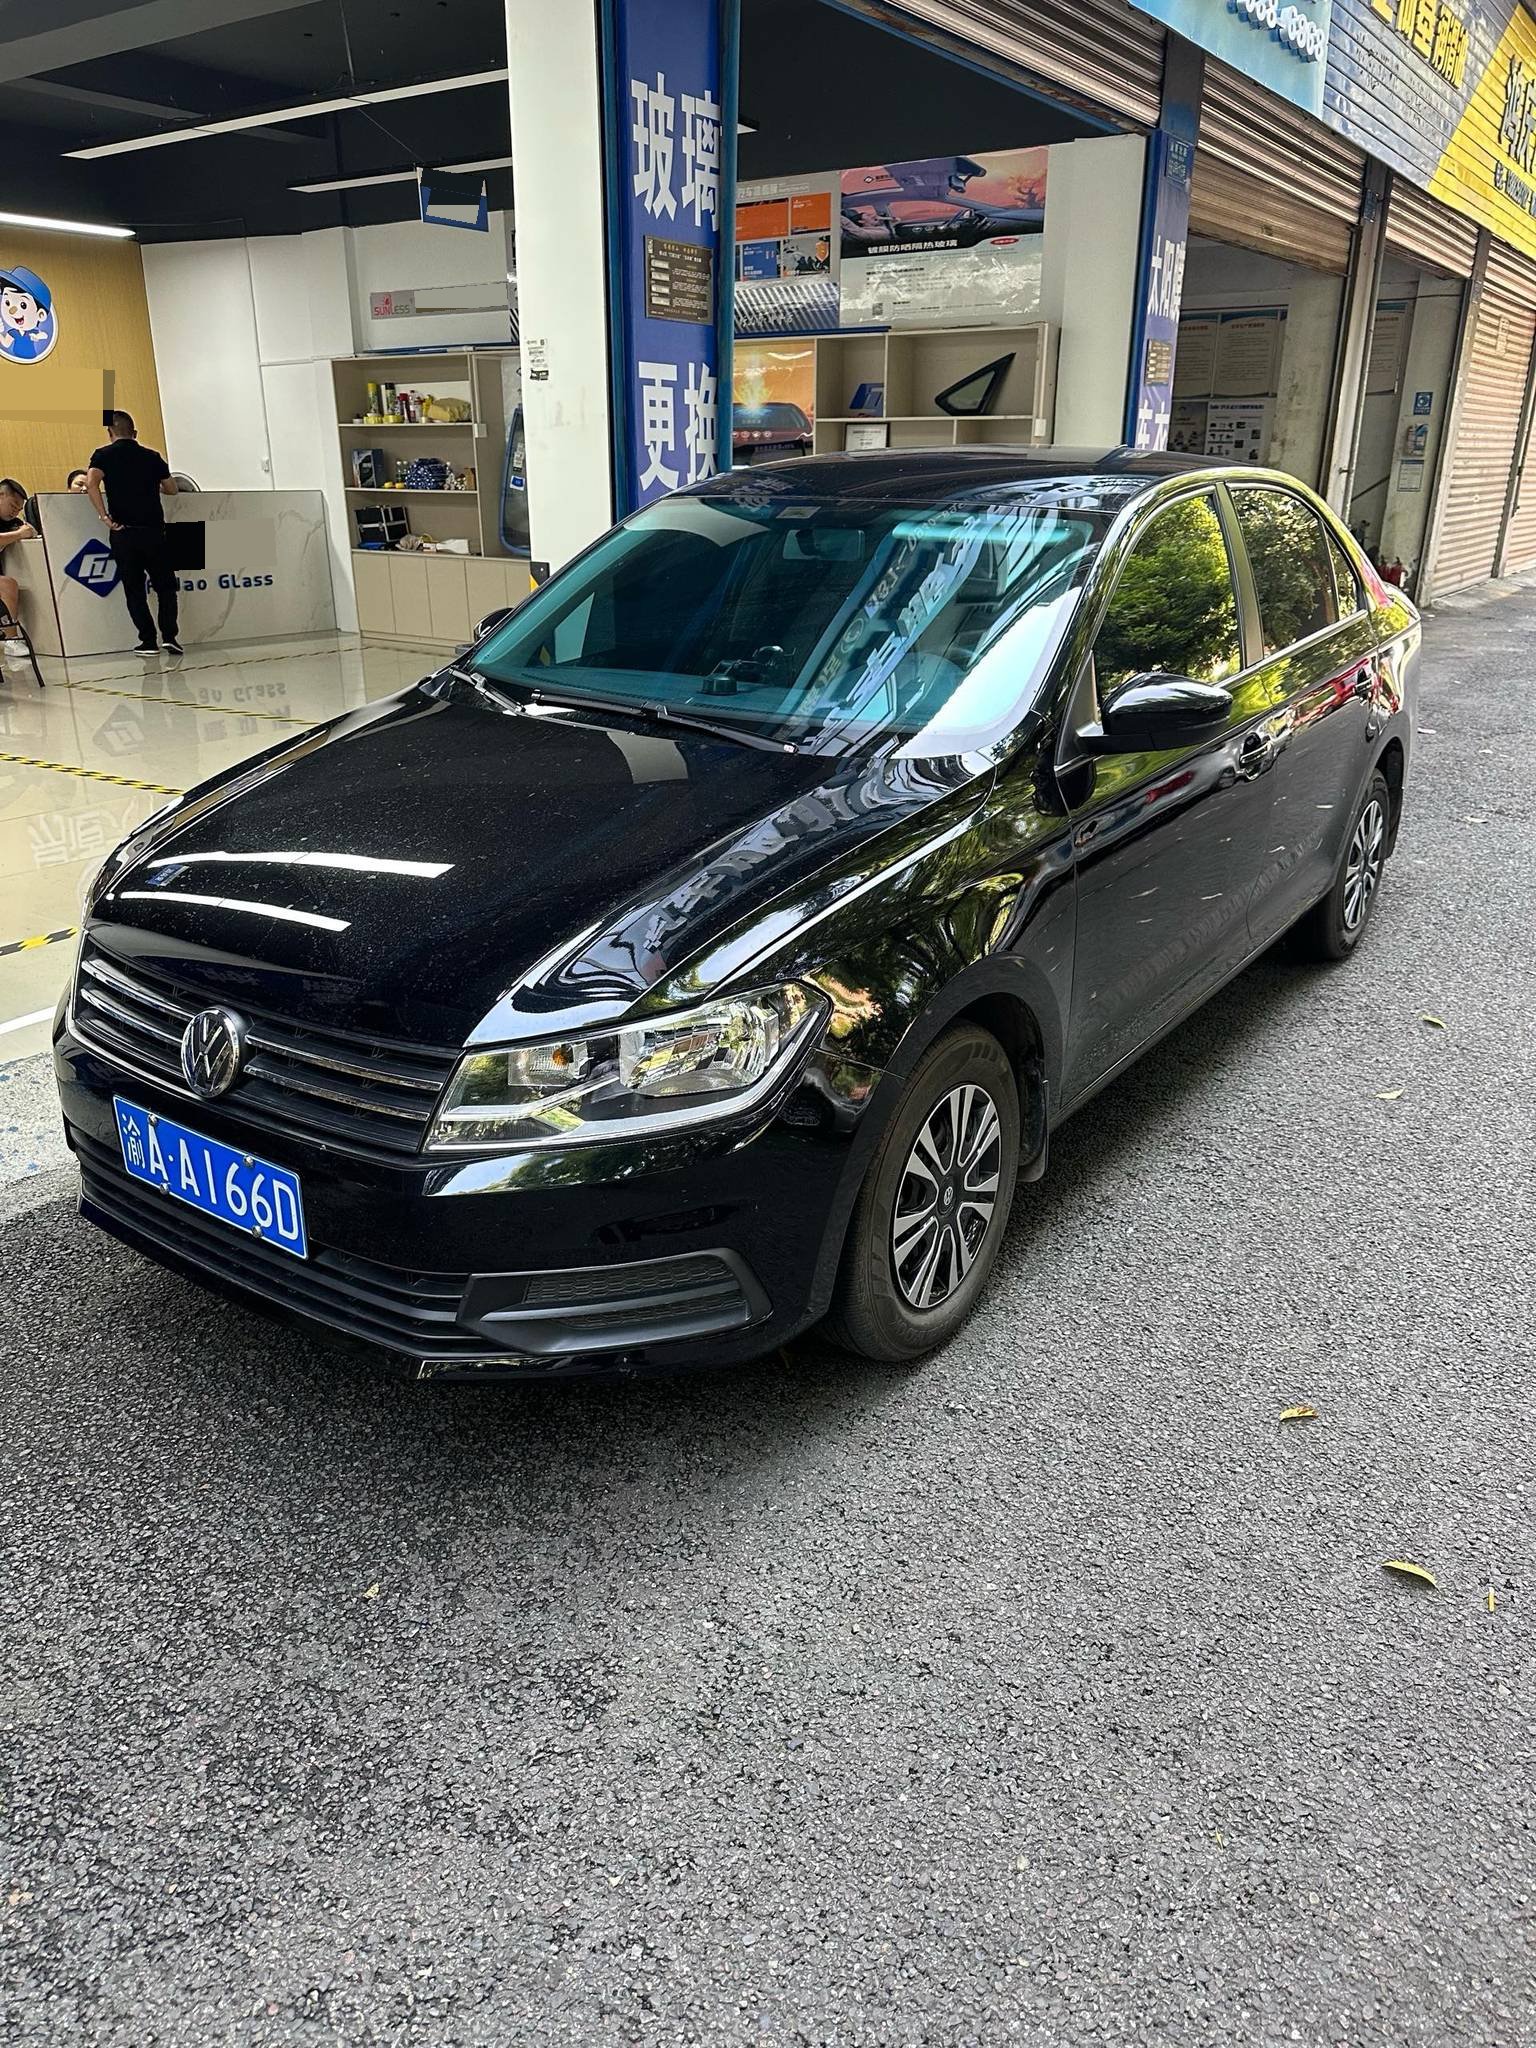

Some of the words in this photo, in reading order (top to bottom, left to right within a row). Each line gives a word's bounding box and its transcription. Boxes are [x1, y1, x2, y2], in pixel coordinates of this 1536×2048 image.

[631, 72, 721, 232] 玻璃
[374, 304, 410, 316] SUNLESS
[638, 361, 719, 491] 更换
[218, 573, 274, 590] Glass
